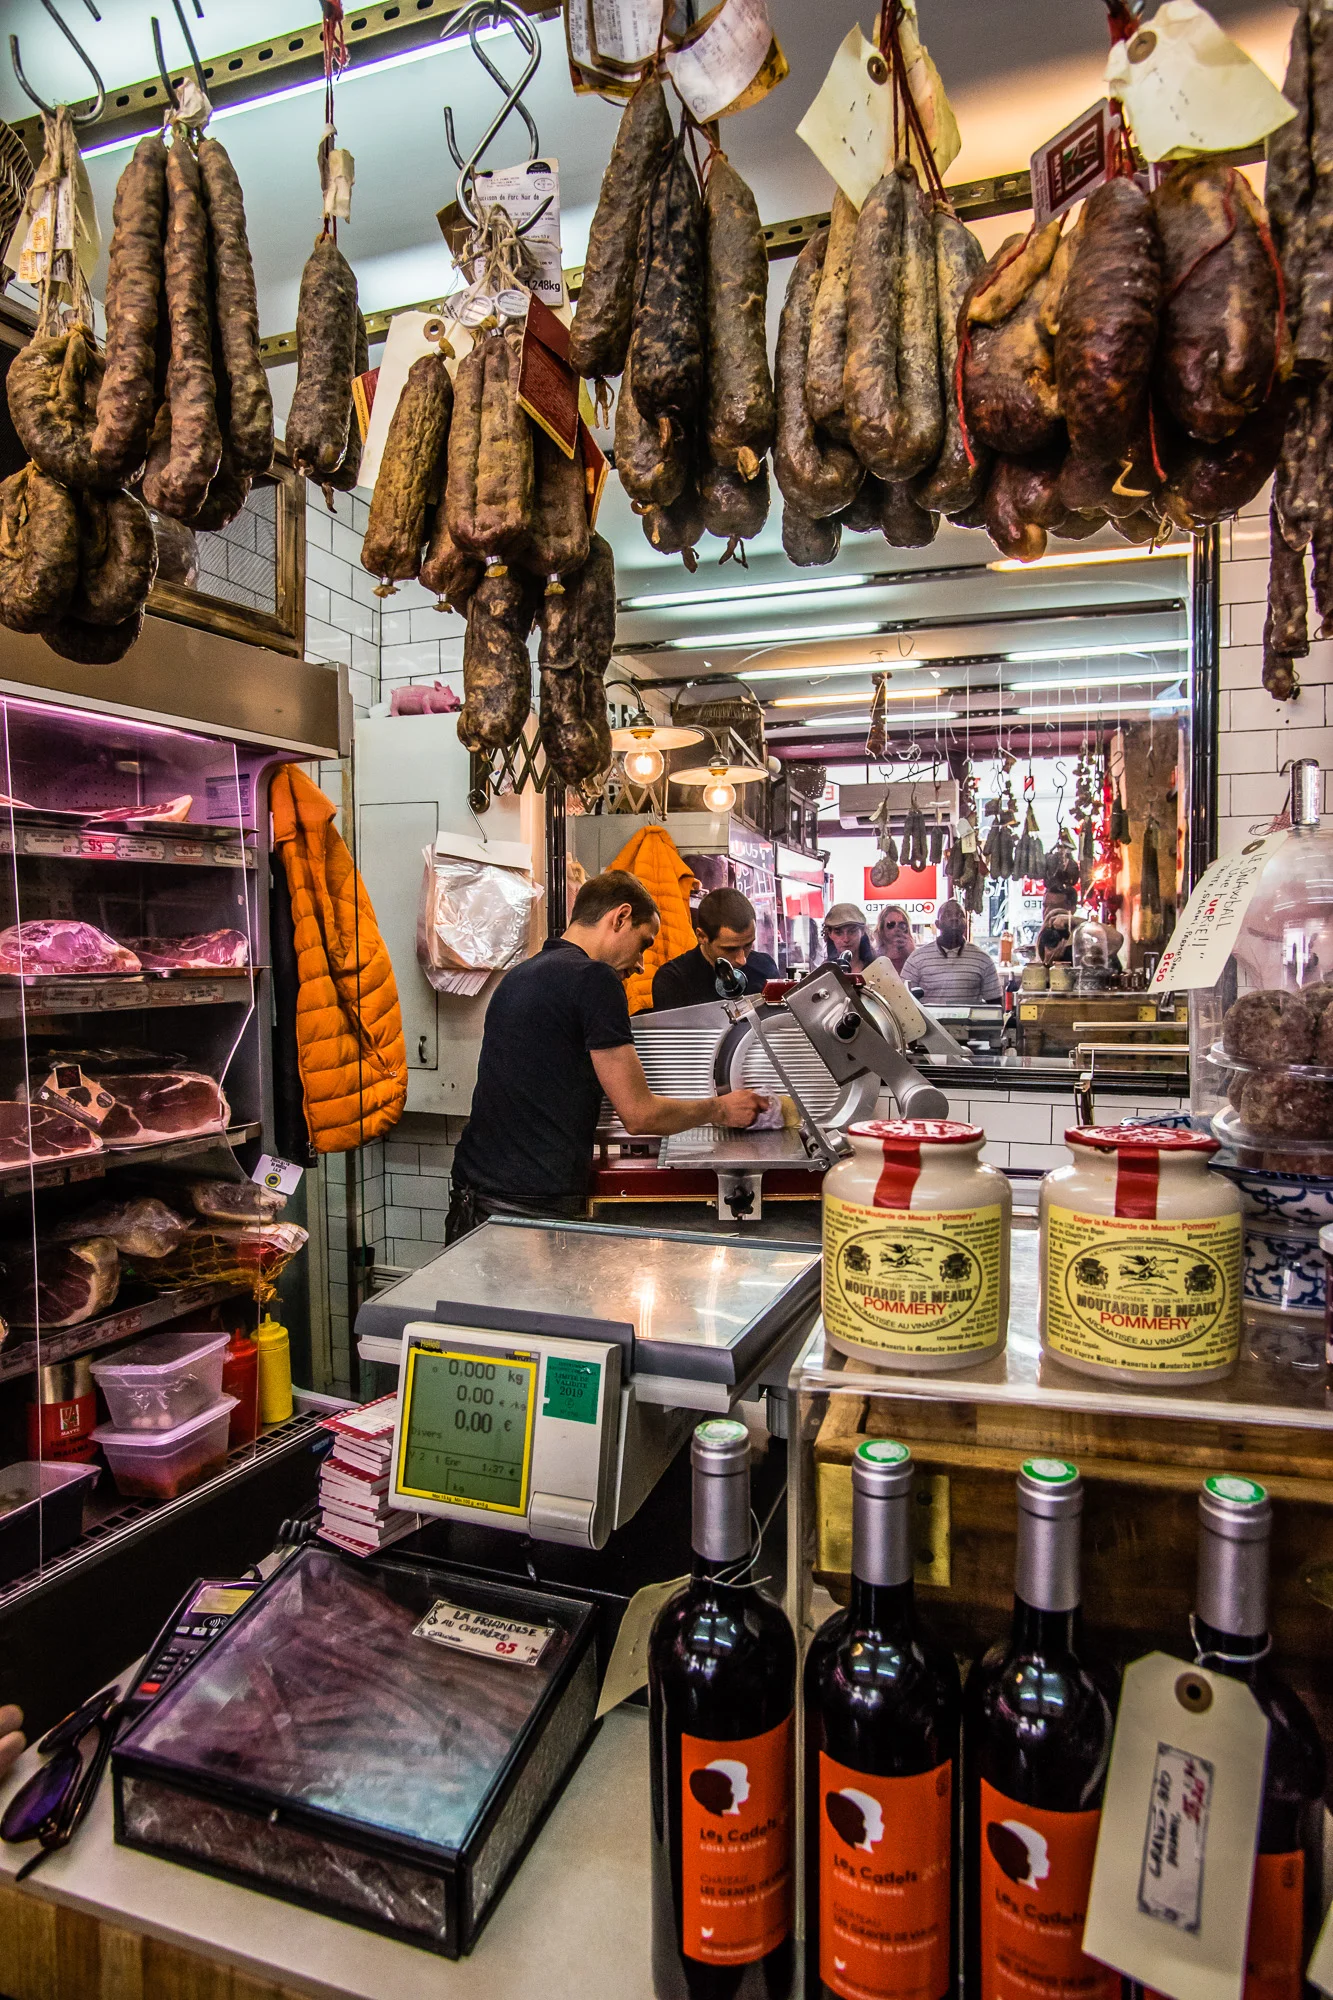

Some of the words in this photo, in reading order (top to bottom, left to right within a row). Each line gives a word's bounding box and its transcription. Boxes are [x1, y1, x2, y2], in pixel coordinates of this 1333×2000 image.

[865, 1210, 895, 1220] Moutarde
[897, 1213, 906, 1221] de
[1073, 1214, 1093, 1225] Exiger
[1094, 1218, 1100, 1226] la
[1102, 1219, 1138, 1230] Moutarde
[1139, 1223, 1149, 1231] de
[1182, 1222, 1216, 1231] Pommery
[845, 1278, 905, 1303] MOUTARDE
[910, 1288, 928, 1303] DE
[931, 1288, 973, 1303] MEAUX
[852, 1301, 896, 1328] AROMATISÉE
[898, 1322, 910, 1330] AU
[911, 1316, 949, 1330] VINAIGRE
[949, 1308, 961, 1321] FIN
[863, 1296, 947, 1316] POMMERY
[1077, 1294, 1148, 1317] MOUTARDE
[1153, 1304, 1171, 1318] DE
[1176, 1302, 1218, 1317] MEAUX
[1100, 1311, 1191, 1330] POMMERY
[1086, 1316, 1138, 1344] AROMATISÉE
[1140, 1338, 1153, 1346] AU
[1154, 1332, 1193, 1346] VINAIGRE
[1194, 1323, 1206, 1336] FIN
[508, 1370, 524, 1386] kg
[560, 1386, 584, 1398] 2019
[504, 1420, 512, 1432] €
[419, 1452, 425, 1461] 2
[445, 1456, 461, 1467] Enr
[453, 1483, 465, 1494] kg
[441, 1619, 454, 1628] AU
[453, 1610, 471, 1621] LA
[473, 1615, 538, 1637] FRIANDISE
[700, 1827, 723, 1844] Les
[728, 1818, 776, 1842] Cadets
[833, 1853, 856, 1876] Les
[860, 1866, 918, 1884] Cadets
